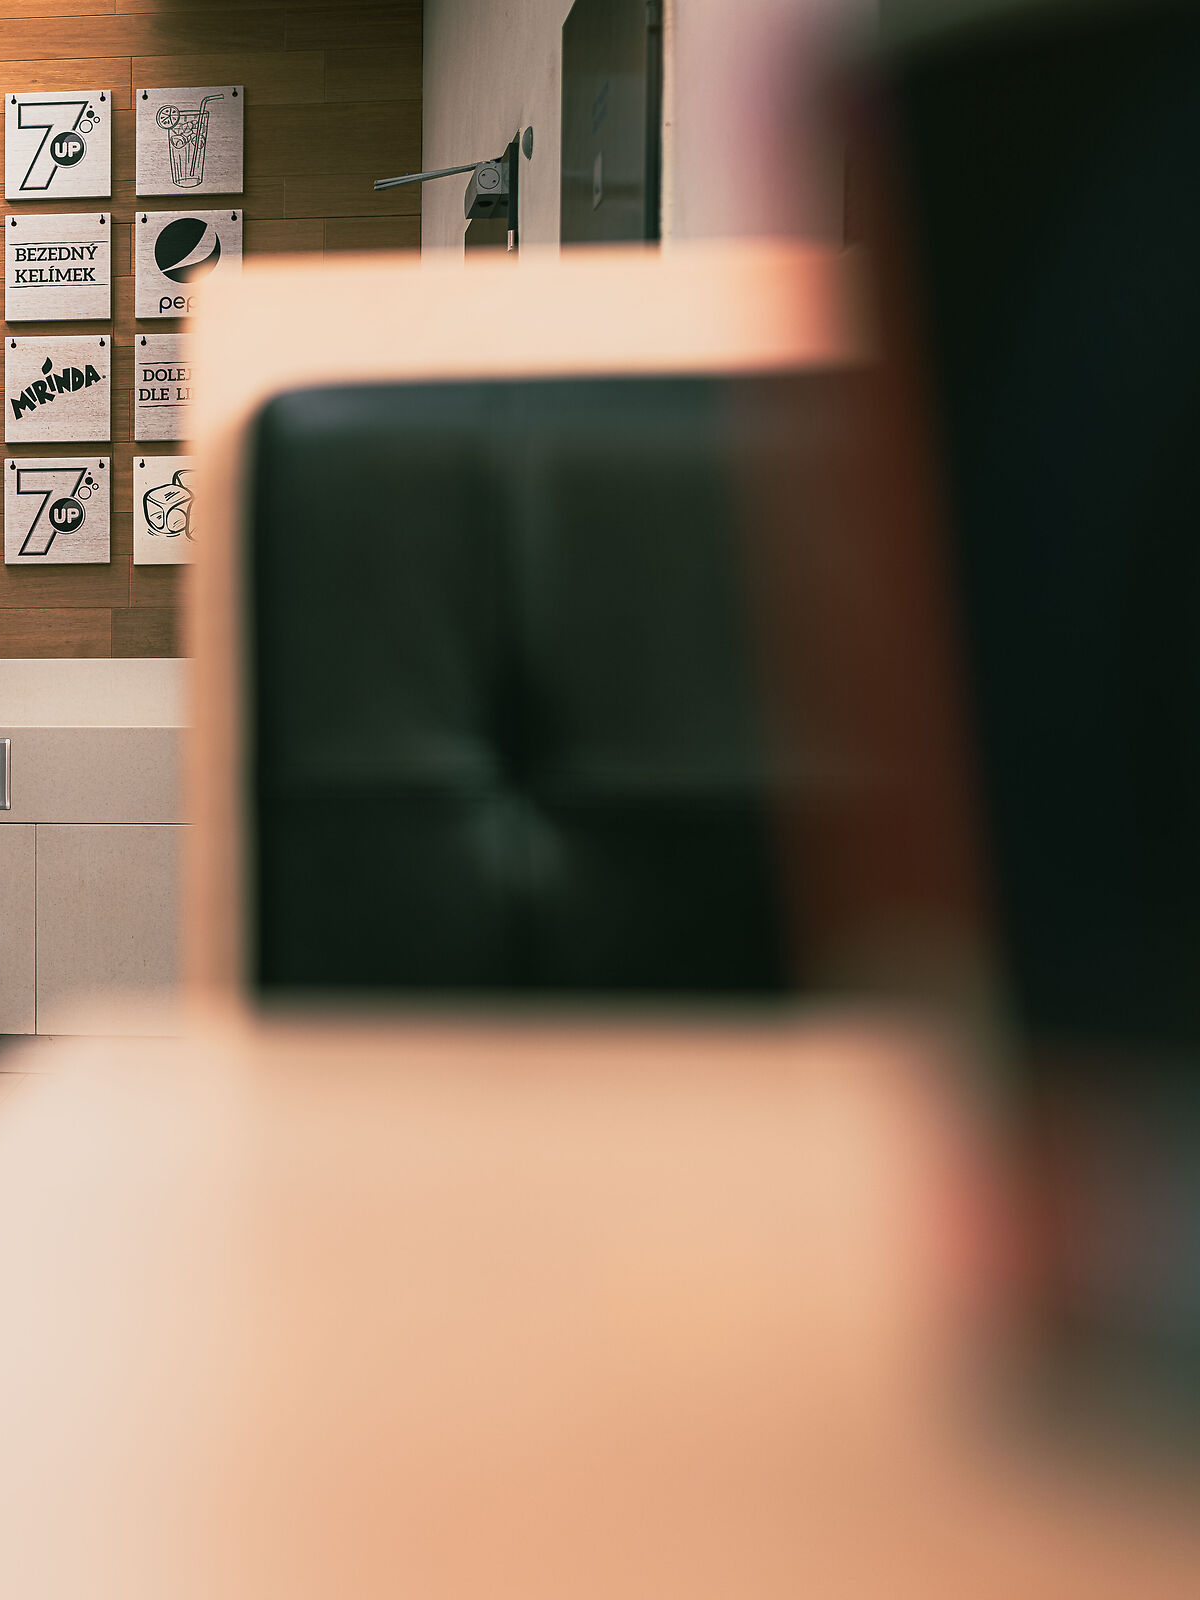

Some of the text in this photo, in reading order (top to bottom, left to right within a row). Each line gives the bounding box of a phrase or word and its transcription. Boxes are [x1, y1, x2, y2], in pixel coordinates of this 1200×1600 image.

[15, 243, 97, 262] BEZEDNÝ
[14, 265, 96, 284] KELÍMEK
[10, 357, 102, 420] MIRINDA
[138, 388, 170, 402] DLE
